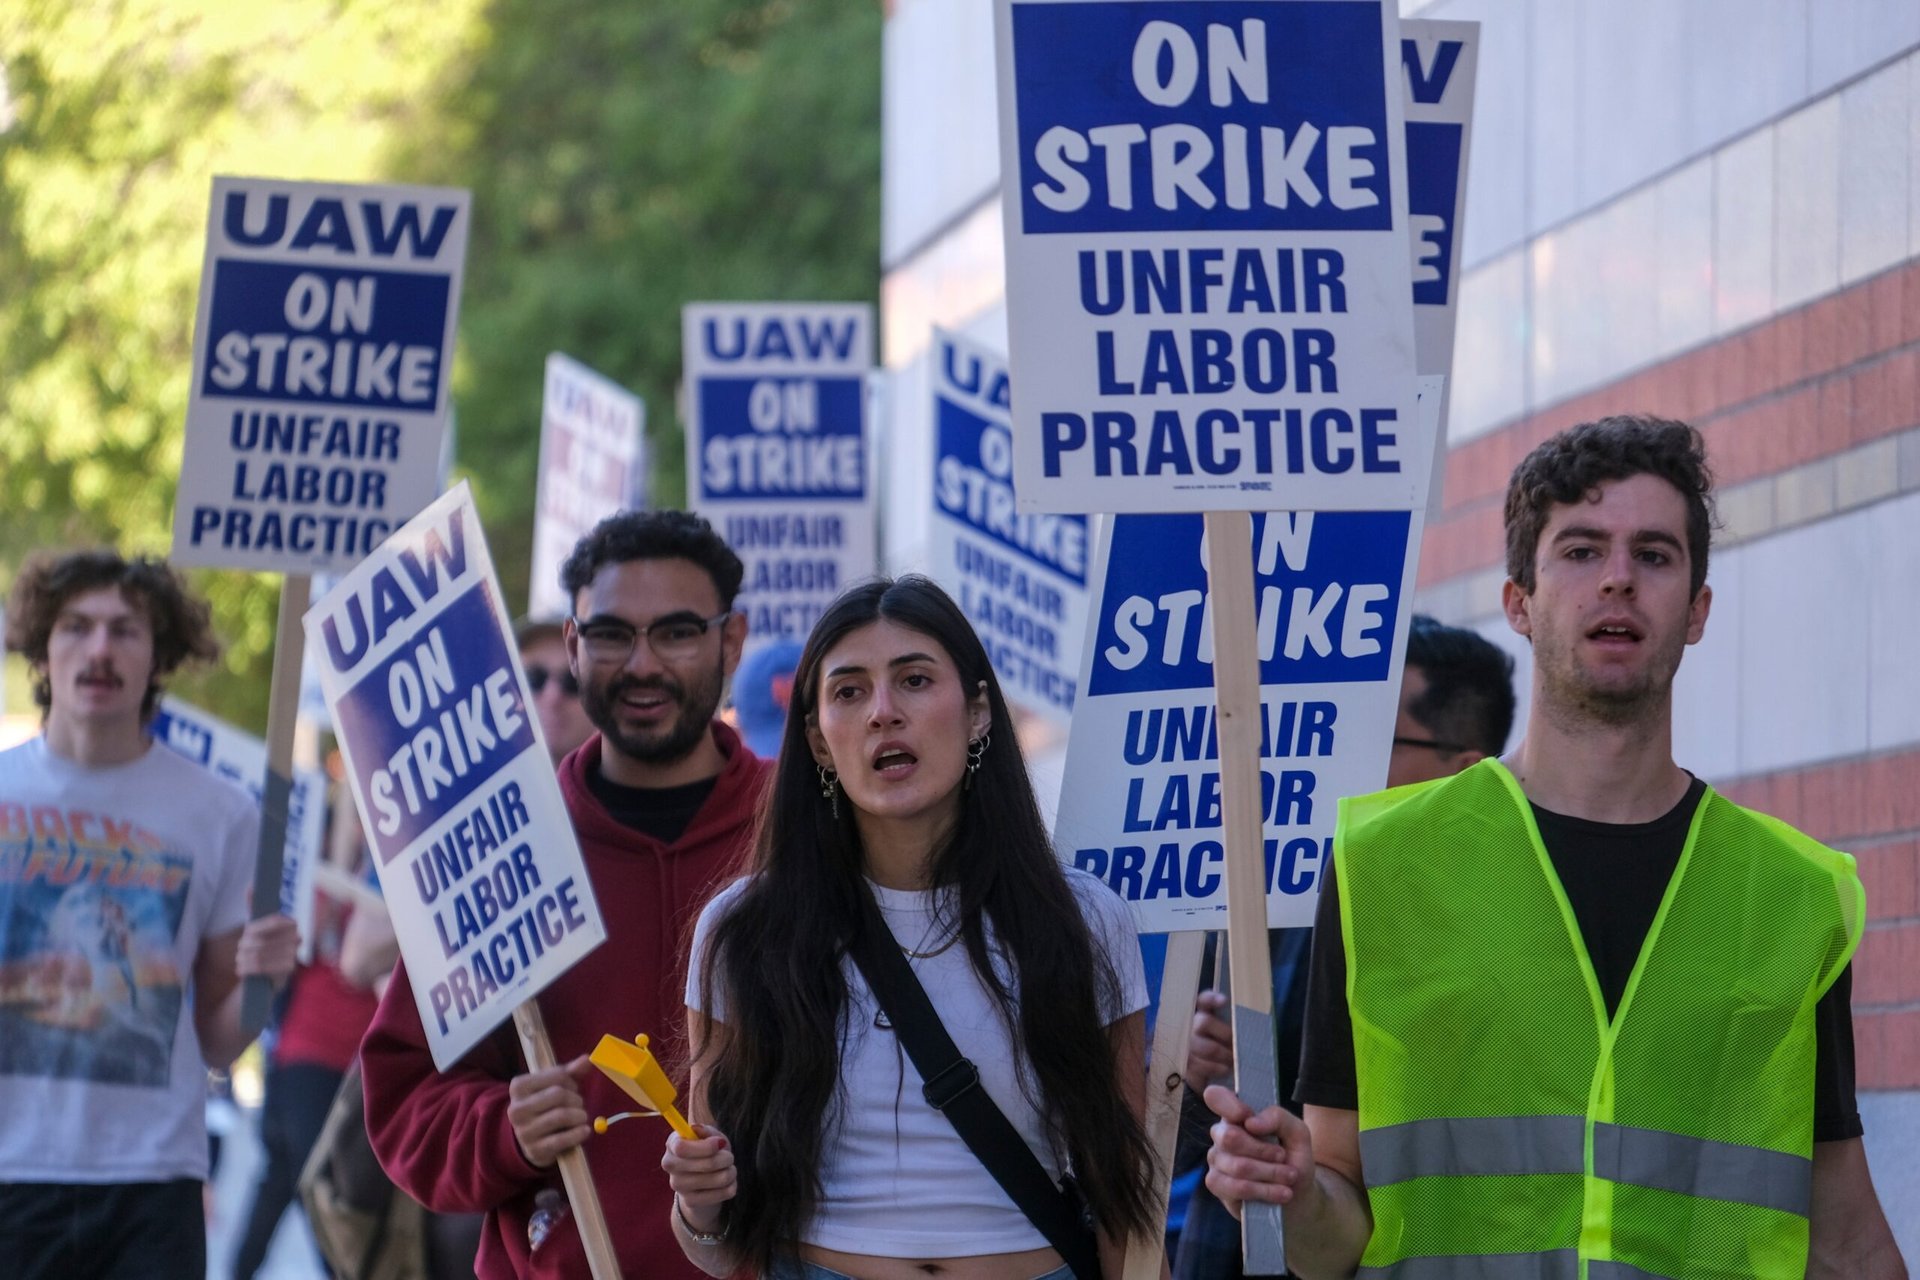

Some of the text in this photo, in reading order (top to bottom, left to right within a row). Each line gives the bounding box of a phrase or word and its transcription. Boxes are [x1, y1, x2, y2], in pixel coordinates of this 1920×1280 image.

[1132, 18, 1269, 107] ON
[1032, 121, 1379, 212] STRIKE
[223, 192, 458, 259] UAW
[284, 273, 376, 333] ON
[1079, 248, 1348, 315] UNFAIR
[210, 331, 436, 402] STRIKE
[706, 317, 856, 361] UAW
[1097, 328, 1339, 395] LABOR
[230, 411, 402, 460] UNFAIR
[749, 380, 819, 434] ON
[705, 433, 861, 493] STRIKE
[1041, 408, 1401, 477] PRACTICE
[233, 461, 388, 509] LABOR
[190, 507, 411, 557] PRACTIC
[726, 513, 843, 549] UNFAIR
[322, 507, 467, 673] UAW
[743, 558, 837, 593] ABOR
[955, 535, 1064, 622] UNFAIR
[387, 626, 455, 728] ON
[370, 667, 522, 837] STRIKE
[1123, 701, 1338, 766] UNIR
[412, 780, 531, 905] UNFAIR
[433, 842, 541, 961] LABOR
[429, 876, 586, 1036] PRACTICE
